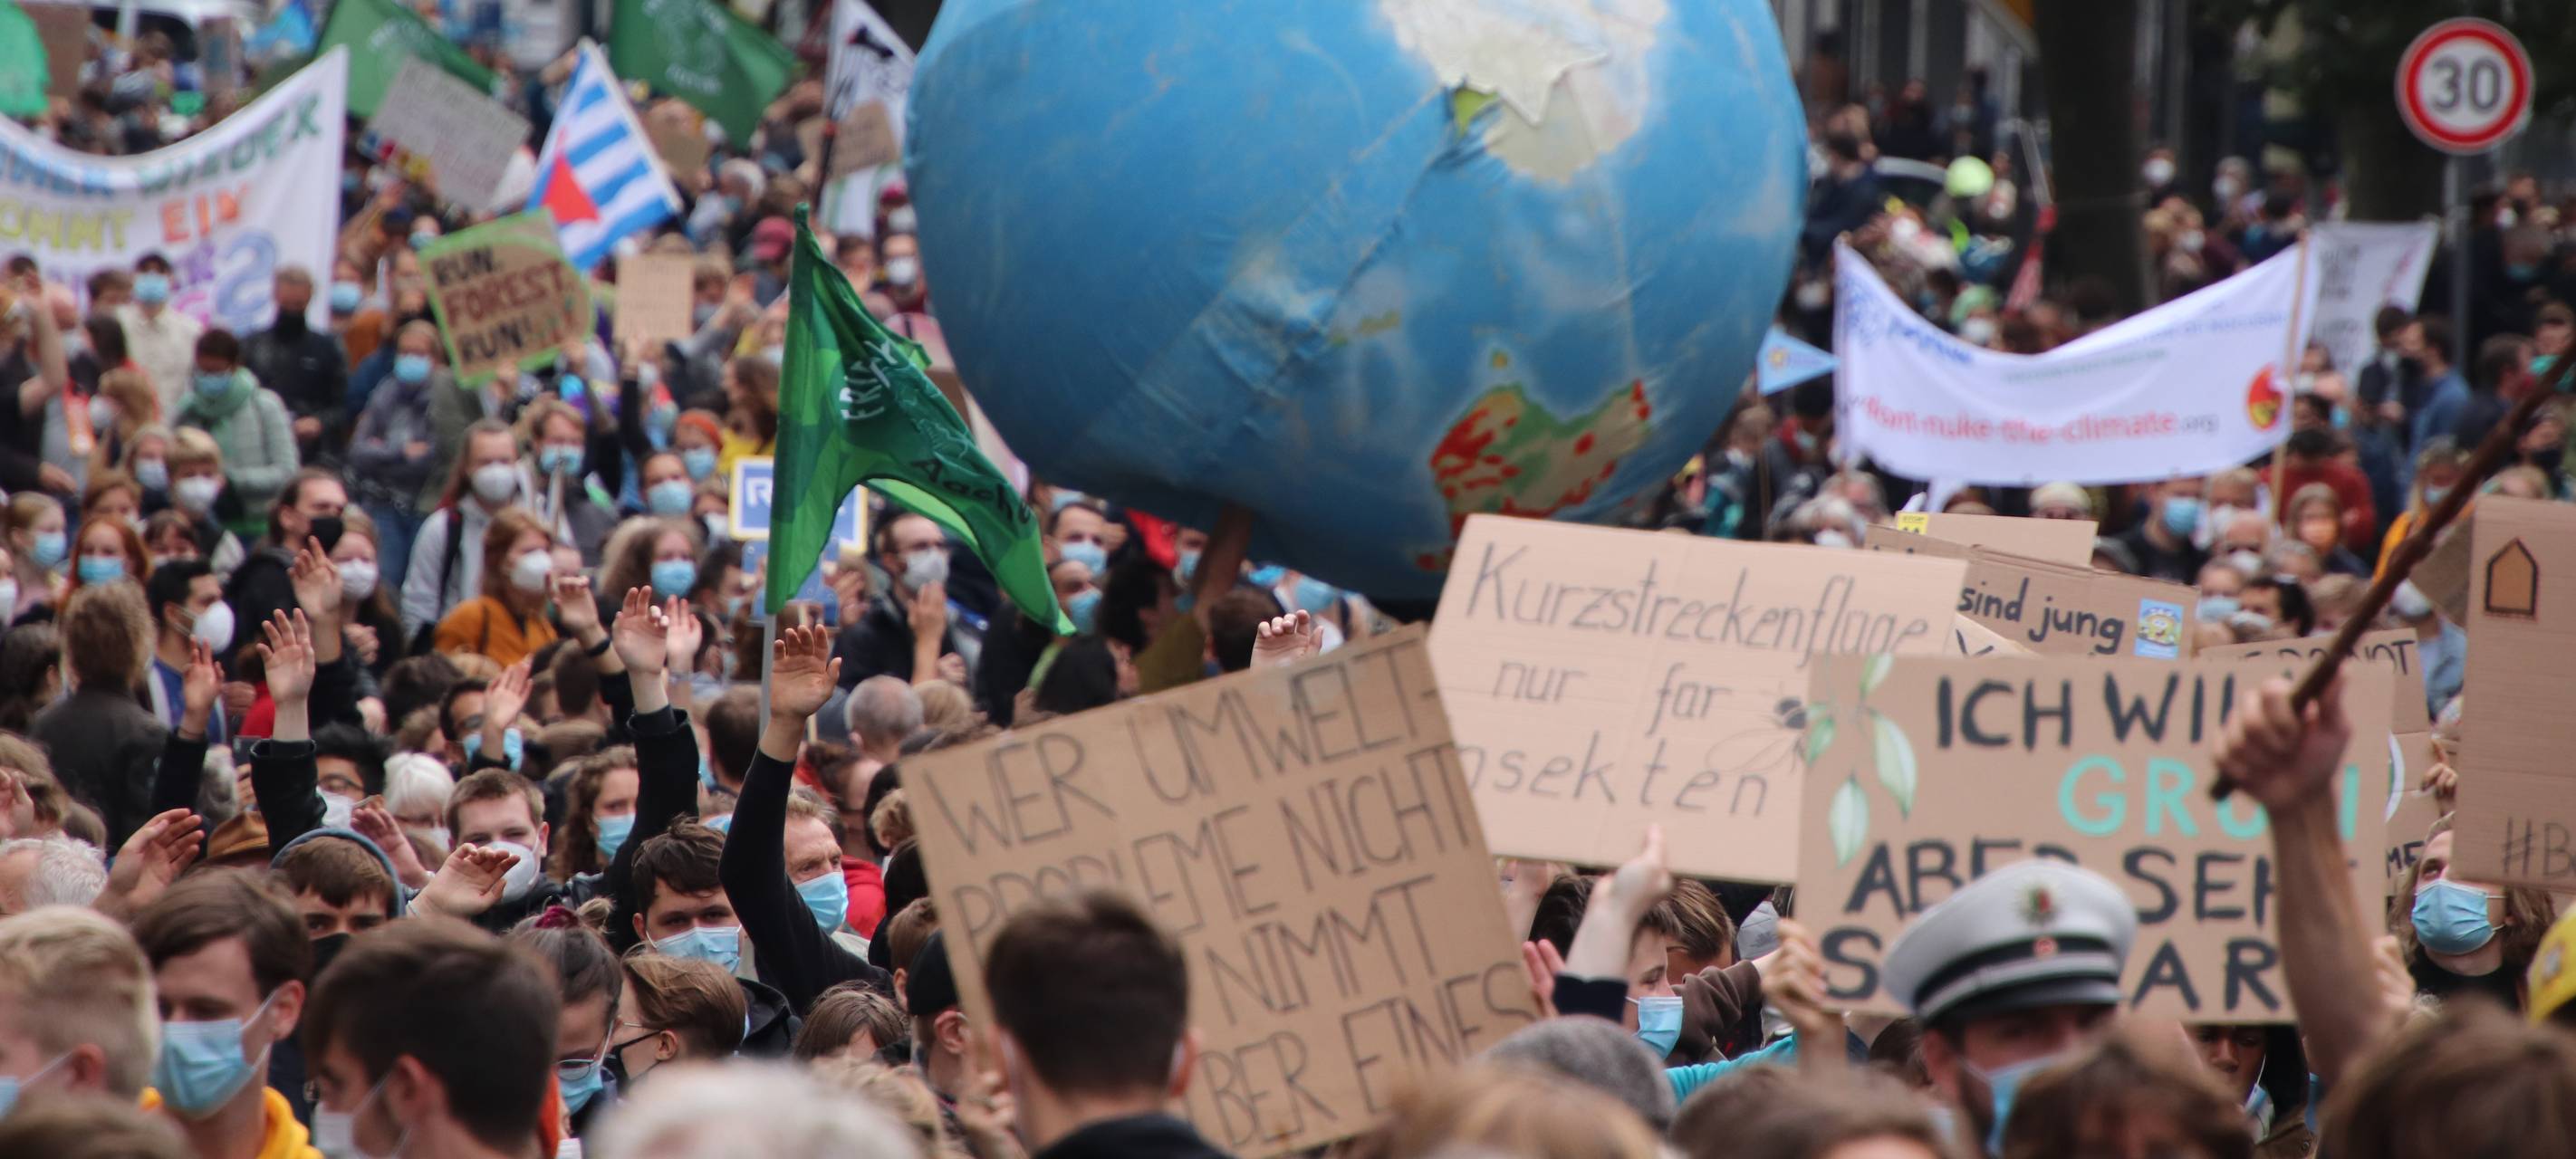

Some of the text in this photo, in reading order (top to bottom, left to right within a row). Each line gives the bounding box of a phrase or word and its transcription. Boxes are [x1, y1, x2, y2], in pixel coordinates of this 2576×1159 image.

[2432, 58, 2503, 112] 30
[1956, 577, 2030, 622] sind
[2027, 595, 2125, 655] jung
[1492, 659, 1588, 704] nur
[1936, 675, 2073, 752] ICH
[921, 637, 1438, 856] WER UMWELT-
[1458, 730, 1769, 818] nsekten
[1277, 741, 1470, 893] NICHT
[2503, 816, 2576, 876] #B
[1205, 873, 1436, 1027] NIMMT
[1183, 1030, 1338, 1147] BER
